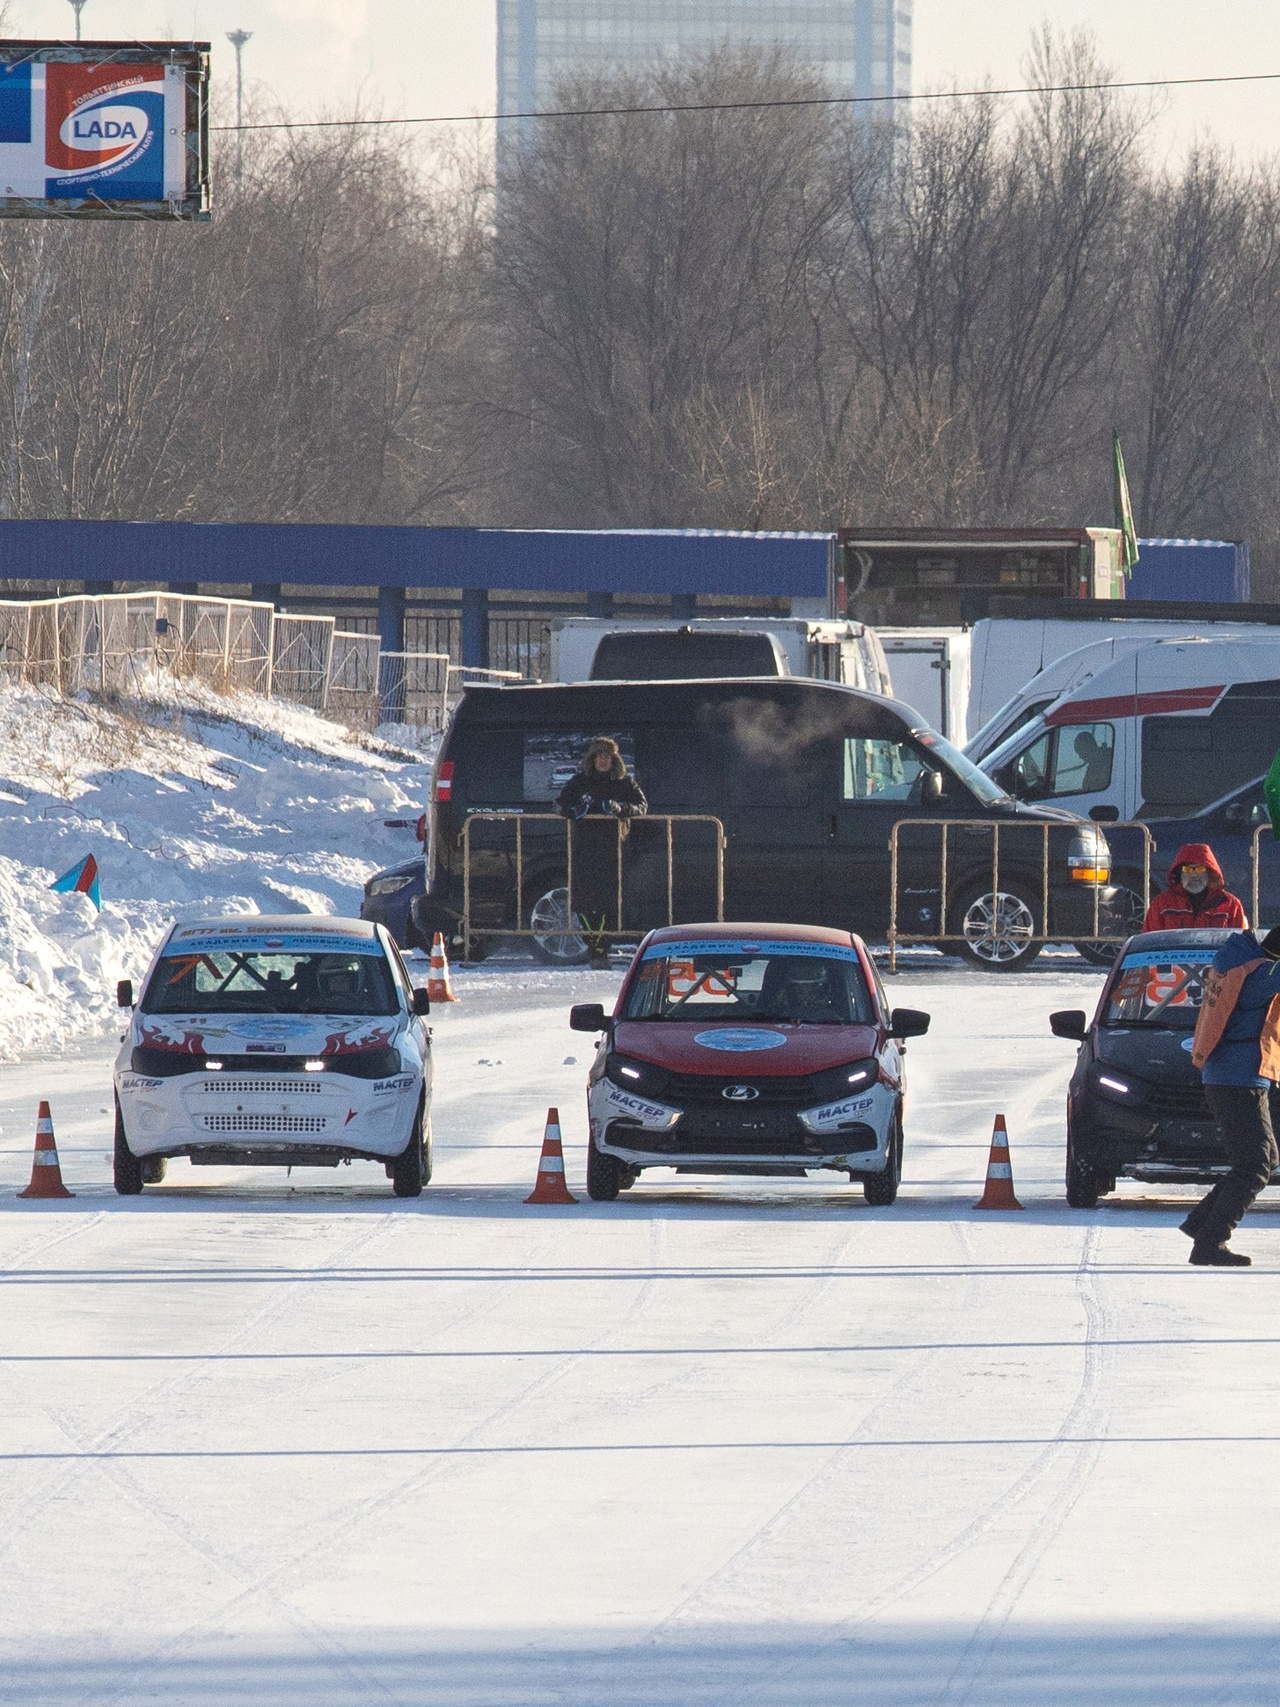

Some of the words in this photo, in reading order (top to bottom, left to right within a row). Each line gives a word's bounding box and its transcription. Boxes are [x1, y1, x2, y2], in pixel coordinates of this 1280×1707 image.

[72, 75, 144, 107] ТОЛЬЯТТИНСКИЙ
[74, 121, 137, 139] LADA
[122, 1078, 164, 1089] МАСТЕР
[373, 1078, 414, 1091] МАСТЕР
[610, 1091, 665, 1116] МАСТЕР
[818, 1098, 873, 1120] МАСТЕР
